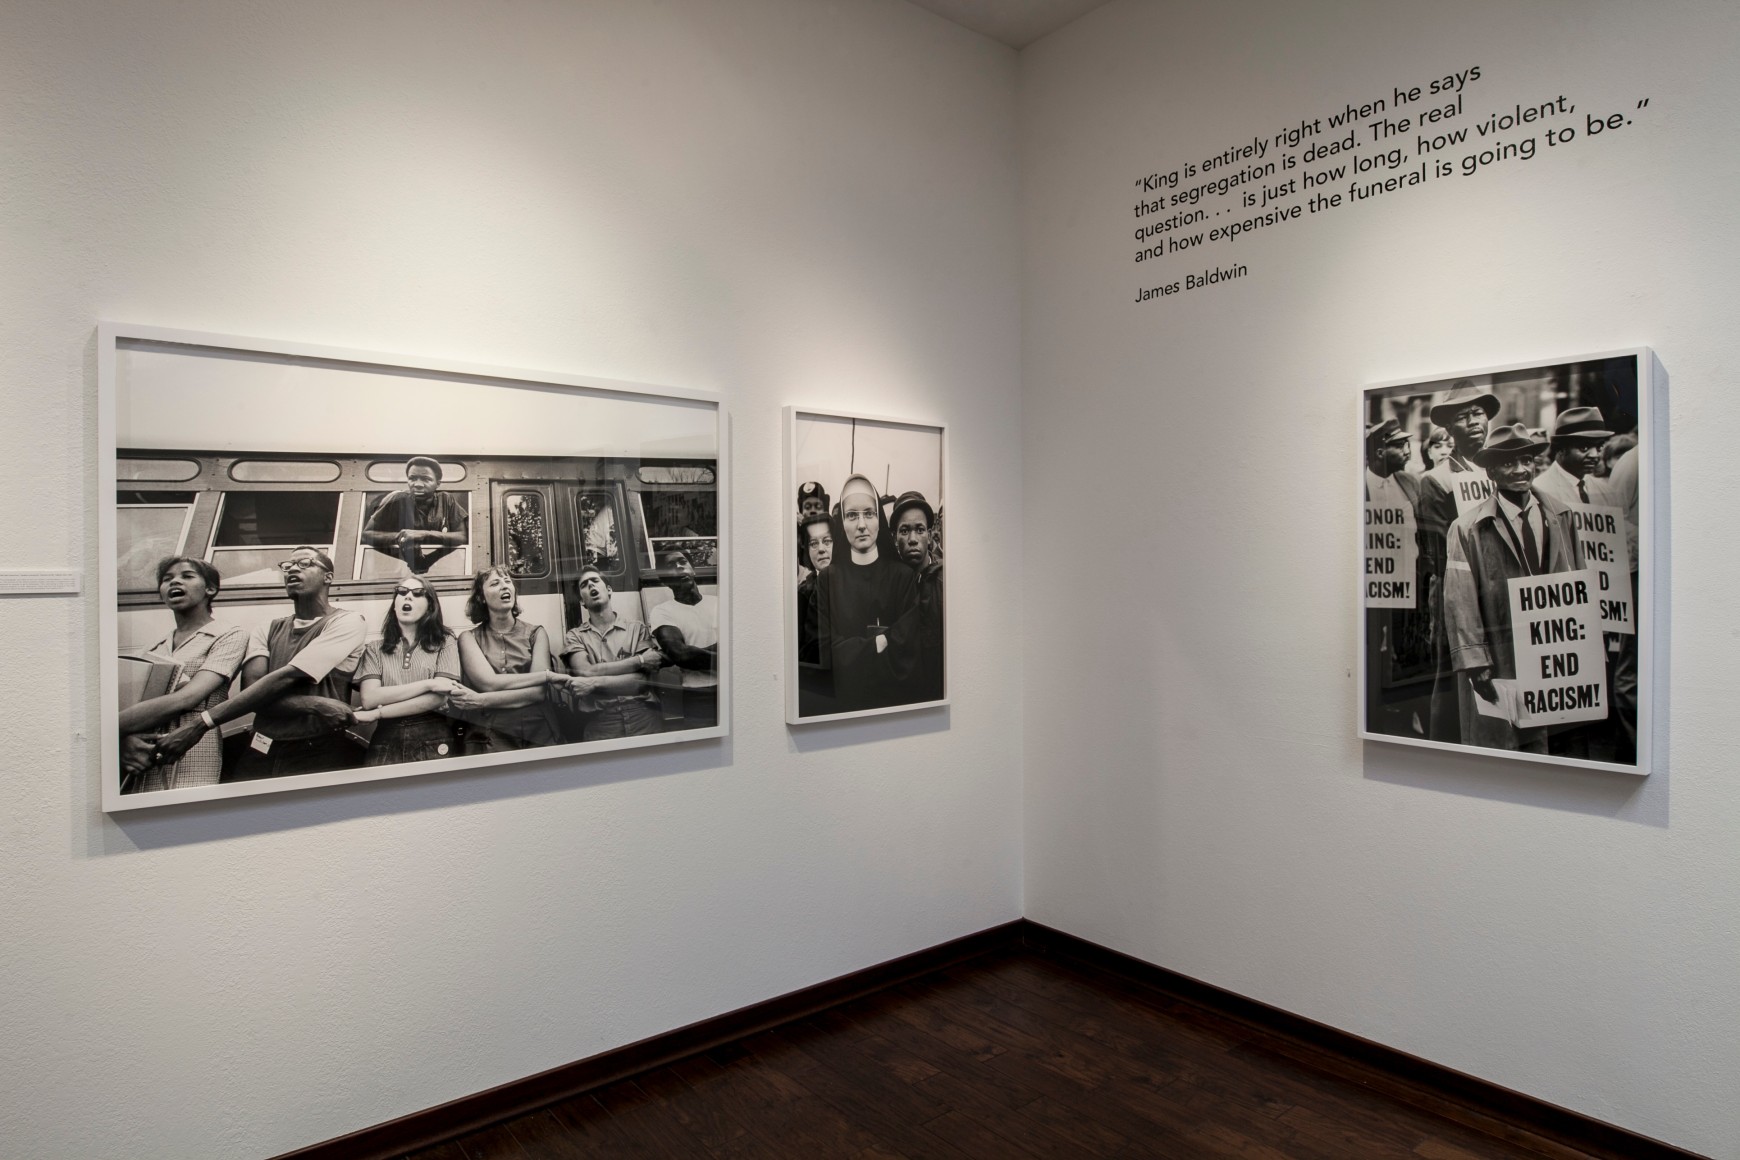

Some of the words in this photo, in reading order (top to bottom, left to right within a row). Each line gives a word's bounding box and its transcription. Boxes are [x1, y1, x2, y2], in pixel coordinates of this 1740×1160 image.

[1184, 162, 1197, 179] is
[1201, 136, 1269, 173] entirely
[1275, 118, 1322, 148] right
[1327, 100, 1386, 129] when
[1393, 87, 1422, 108] he
[1429, 65, 1482, 95] says
[1133, 196, 1166, 218] that
[1170, 162, 1275, 207] segregation
[1282, 153, 1297, 171] is
[1302, 130, 1361, 163] dead.
[1368, 118, 1411, 142] The
[1419, 93, 1463, 127] real
[1242, 191, 1257, 208] is
[1260, 178, 1297, 208] just
[1303, 165, 1347, 190] how
[1353, 148, 1409, 175] long,
[1417, 127, 1469, 156] how
[1475, 94, 1576, 137] violent,
[1134, 239, 1164, 263] and
[1169, 232, 1204, 254] how
[1209, 205, 1302, 243] expensive
[1307, 192, 1342, 214] the
[1348, 161, 1427, 203] funeral
[1435, 159, 1453, 179] is
[1461, 137, 1536, 177] going
[1544, 127, 1576, 147] to
[1134, 281, 1180, 303] James
[1185, 263, 1248, 291] Baldwin
[1459, 479, 1497, 502] HON
[1365, 508, 1405, 525] ONOR
[1573, 510, 1617, 535] ONOR
[1365, 532, 1401, 549] ING:
[1580, 540, 1615, 563] ING:
[1365, 557, 1395, 574] END
[1365, 581, 1411, 599] CISM!
[1519, 580, 1589, 612] HONOR
[1529, 616, 1586, 646] KING:
[1540, 652, 1579, 679] END
[1523, 683, 1600, 714] RACISM!
